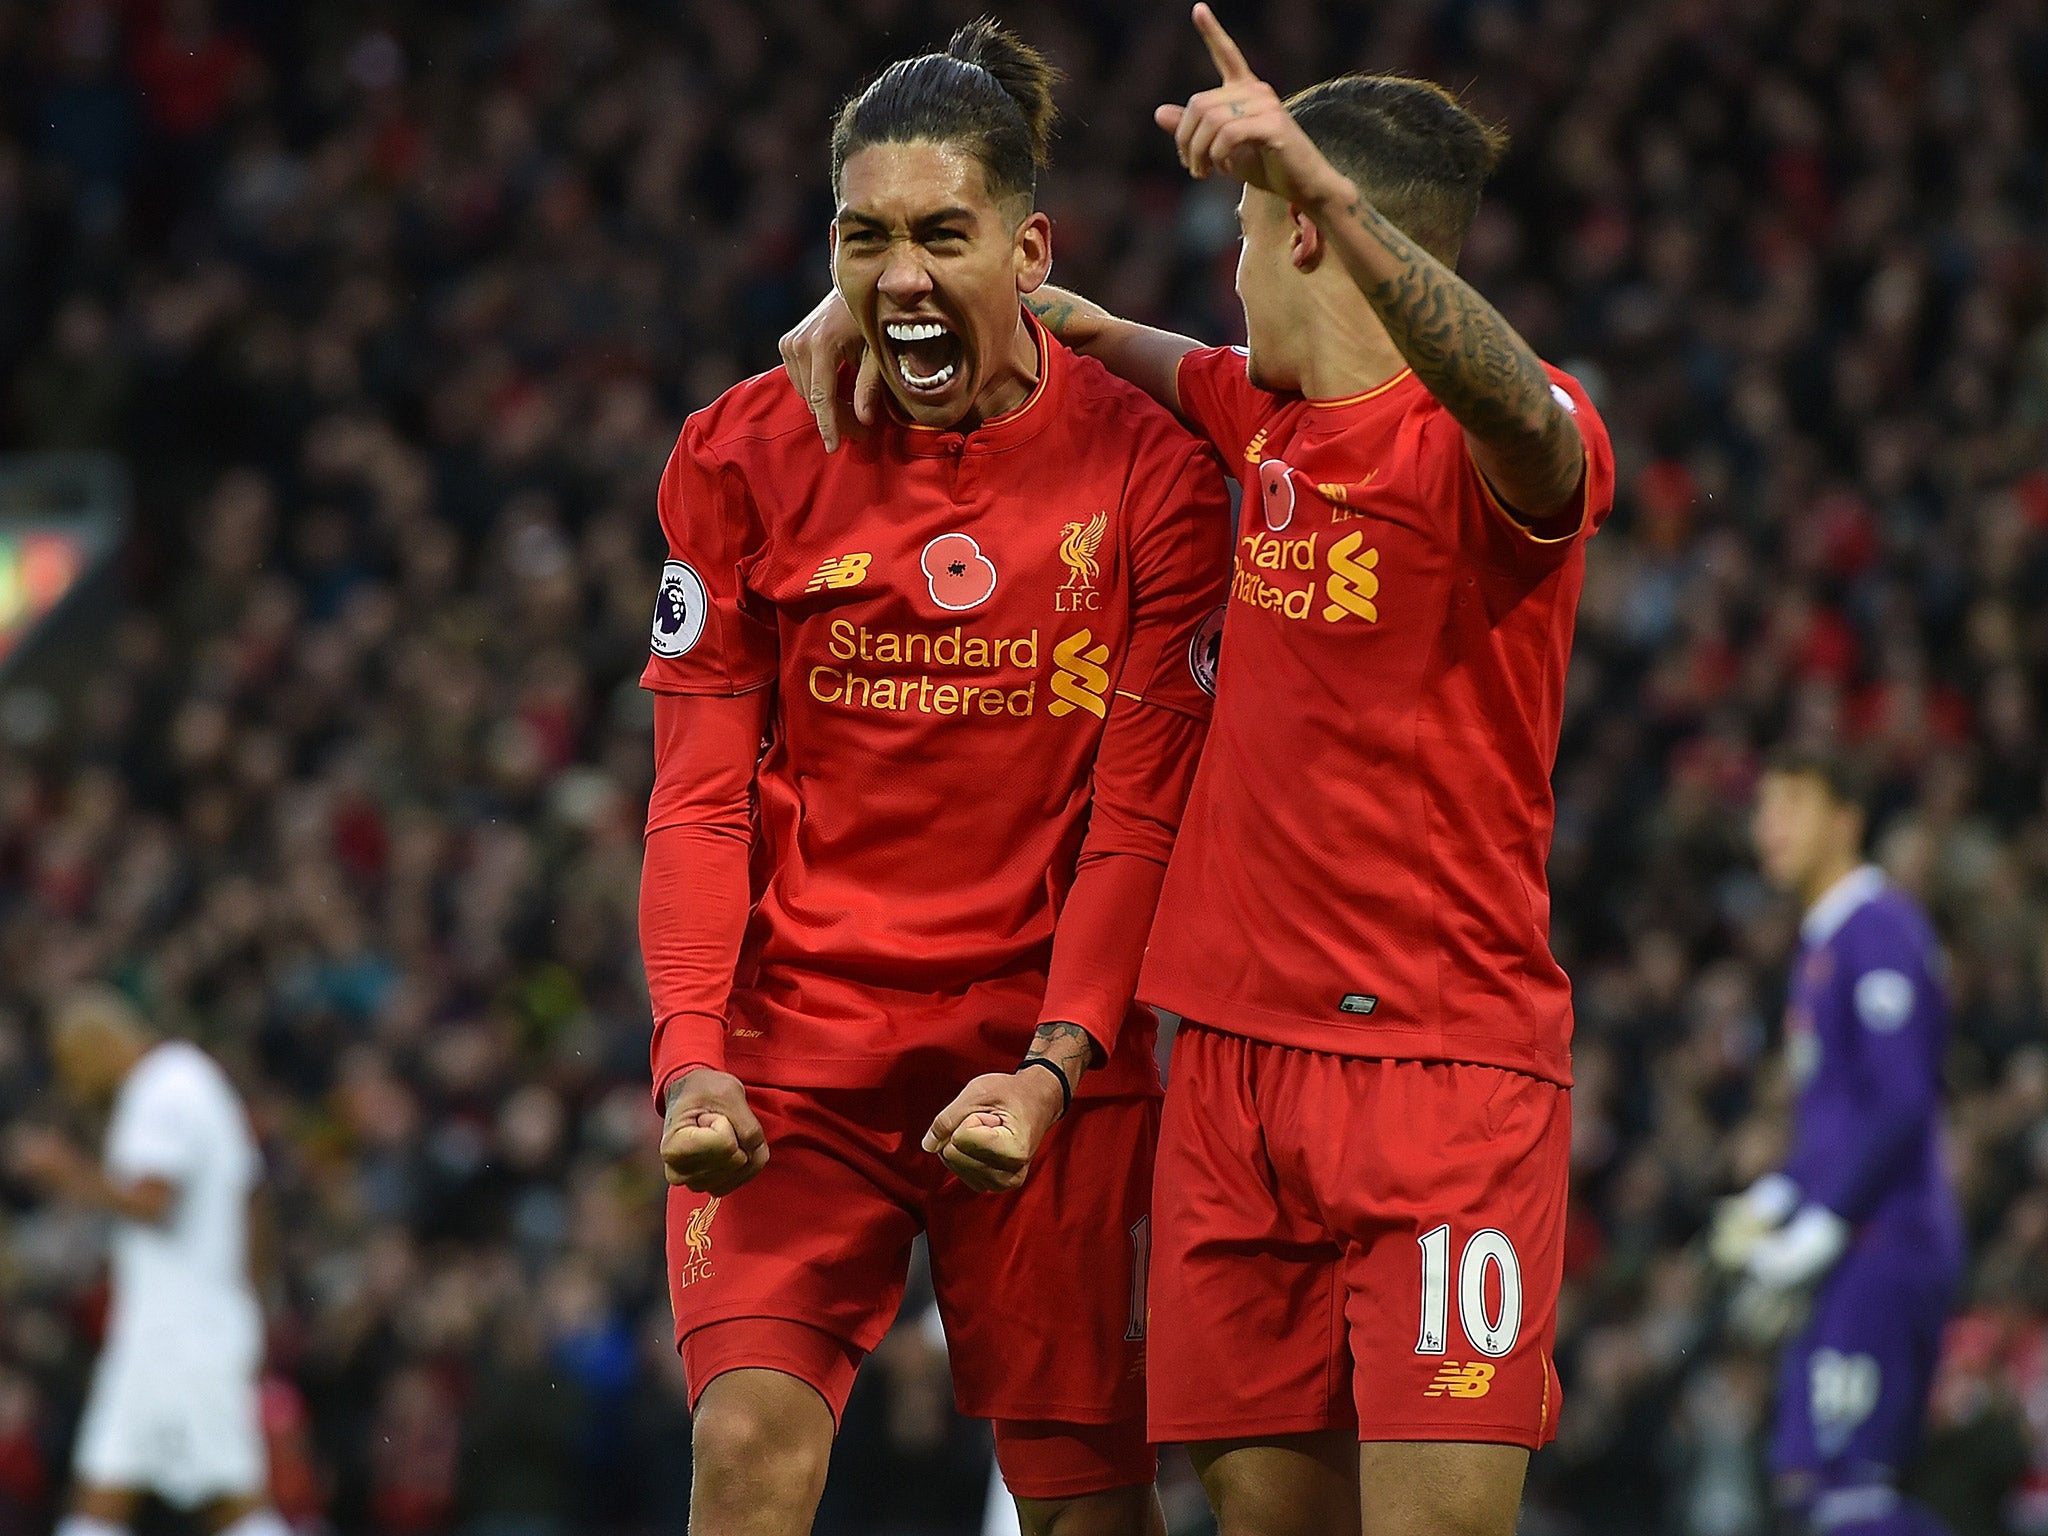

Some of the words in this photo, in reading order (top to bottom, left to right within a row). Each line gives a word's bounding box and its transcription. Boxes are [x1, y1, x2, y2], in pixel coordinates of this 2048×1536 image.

[804, 552, 873, 593] NB
[828, 619, 1039, 669] Standard
[807, 666, 1036, 717] Chartered
[1414, 1223, 1523, 1358] 10
[1423, 1360, 1496, 1399] NB
